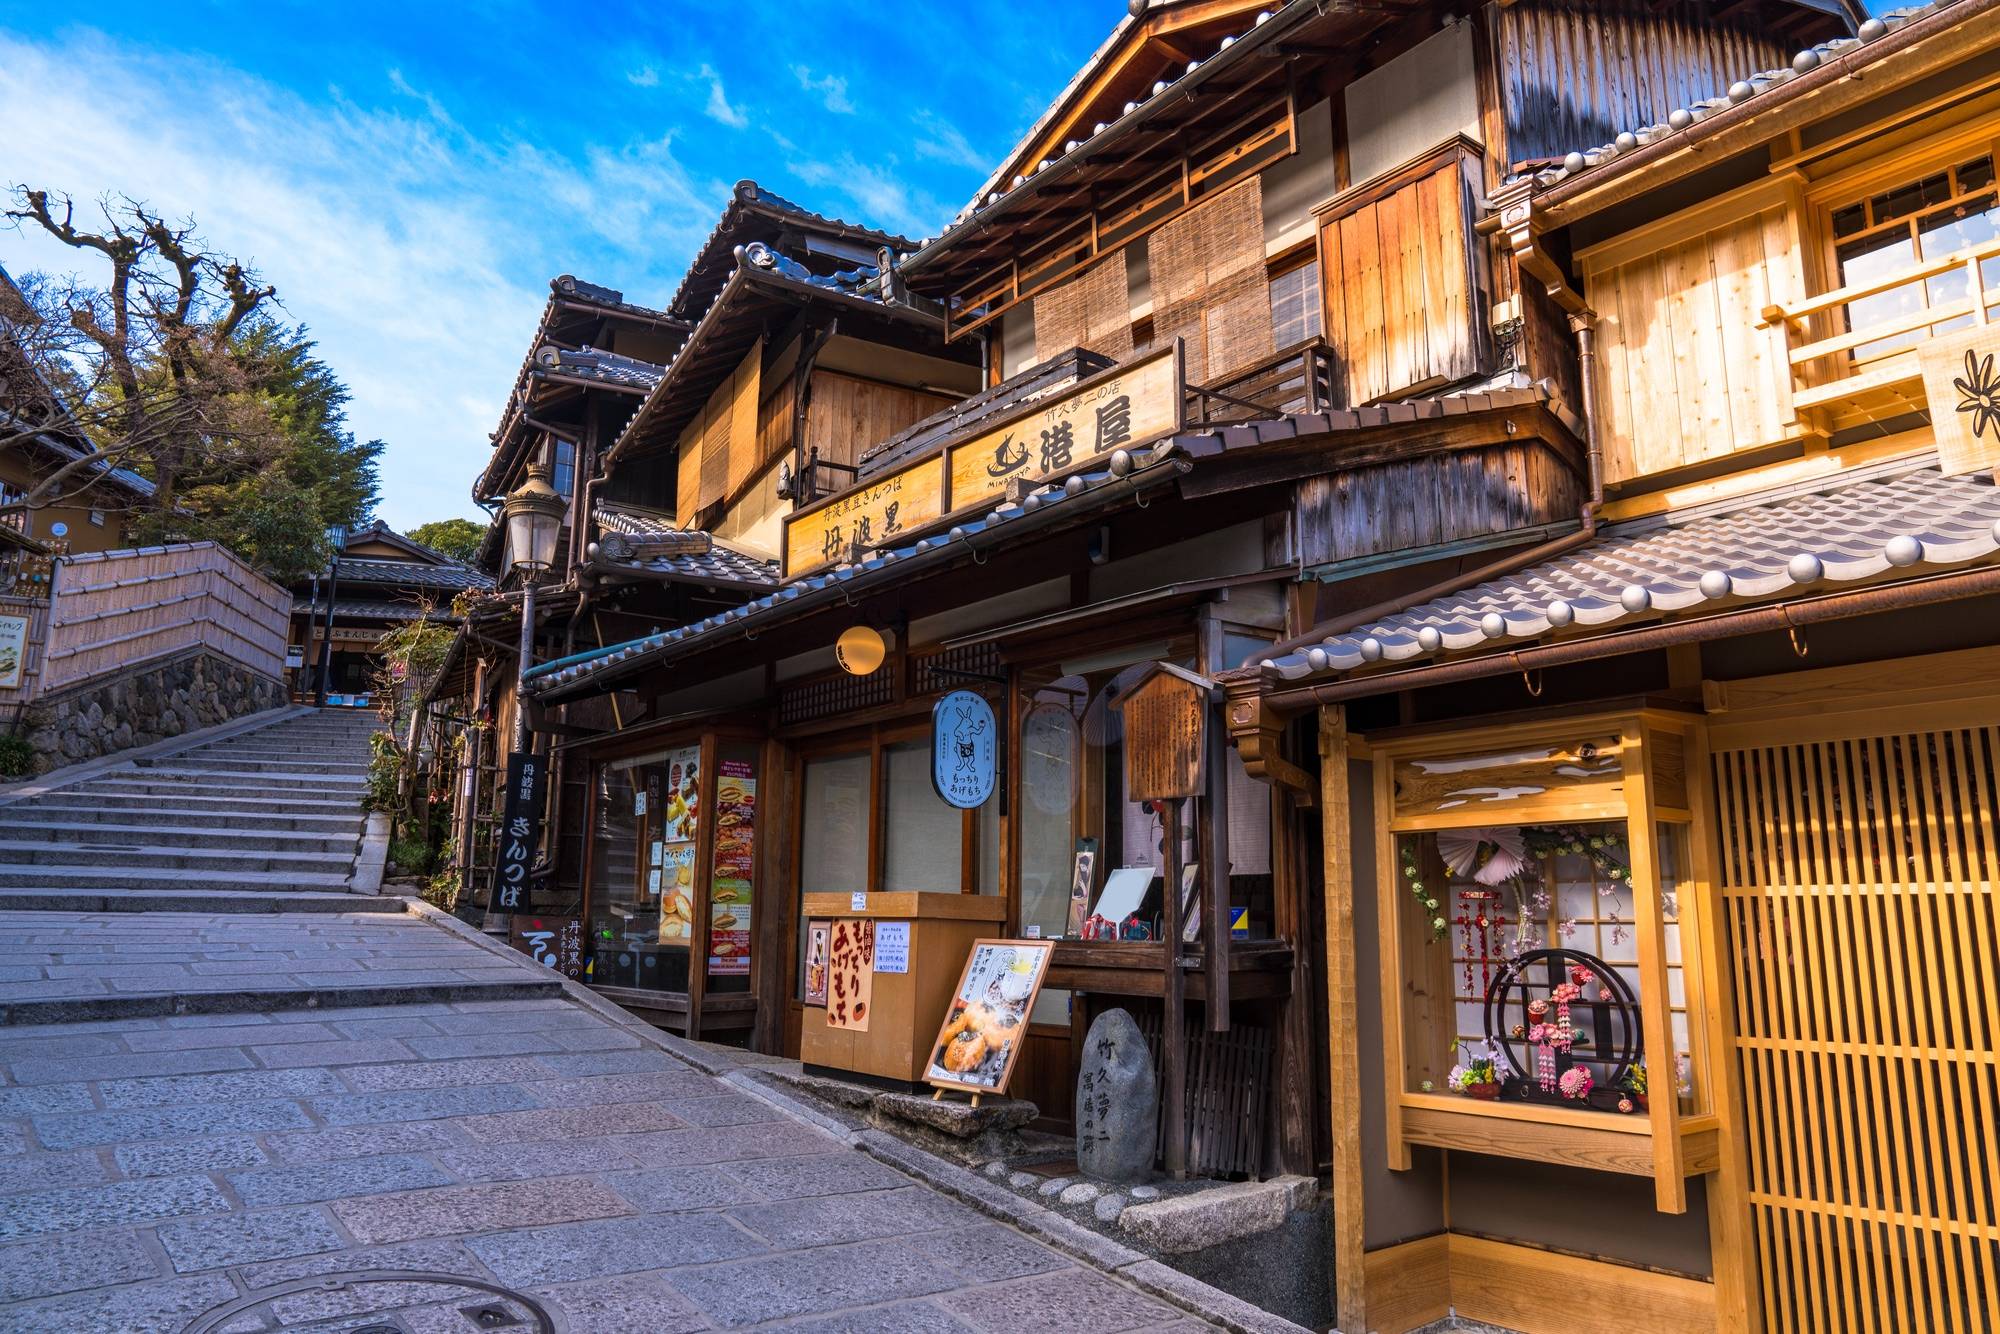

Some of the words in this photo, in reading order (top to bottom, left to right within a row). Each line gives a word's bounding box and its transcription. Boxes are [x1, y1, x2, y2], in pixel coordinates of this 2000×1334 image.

[1045, 380, 1121, 422] 竹久夢二の店
[1040, 395, 1131, 473] 港屋
[822, 501, 903, 561] 丹波黒
[519, 763, 535, 800] 丹波黒
[950, 784, 981, 796] あげもち
[952, 773, 979, 785] もっちり
[568, 920, 581, 976] 丹波黒の
[833, 924, 853, 1026] あげもち
[850, 921, 863, 998] もっちり
[1097, 1038, 1116, 1142] 竹久夢二
